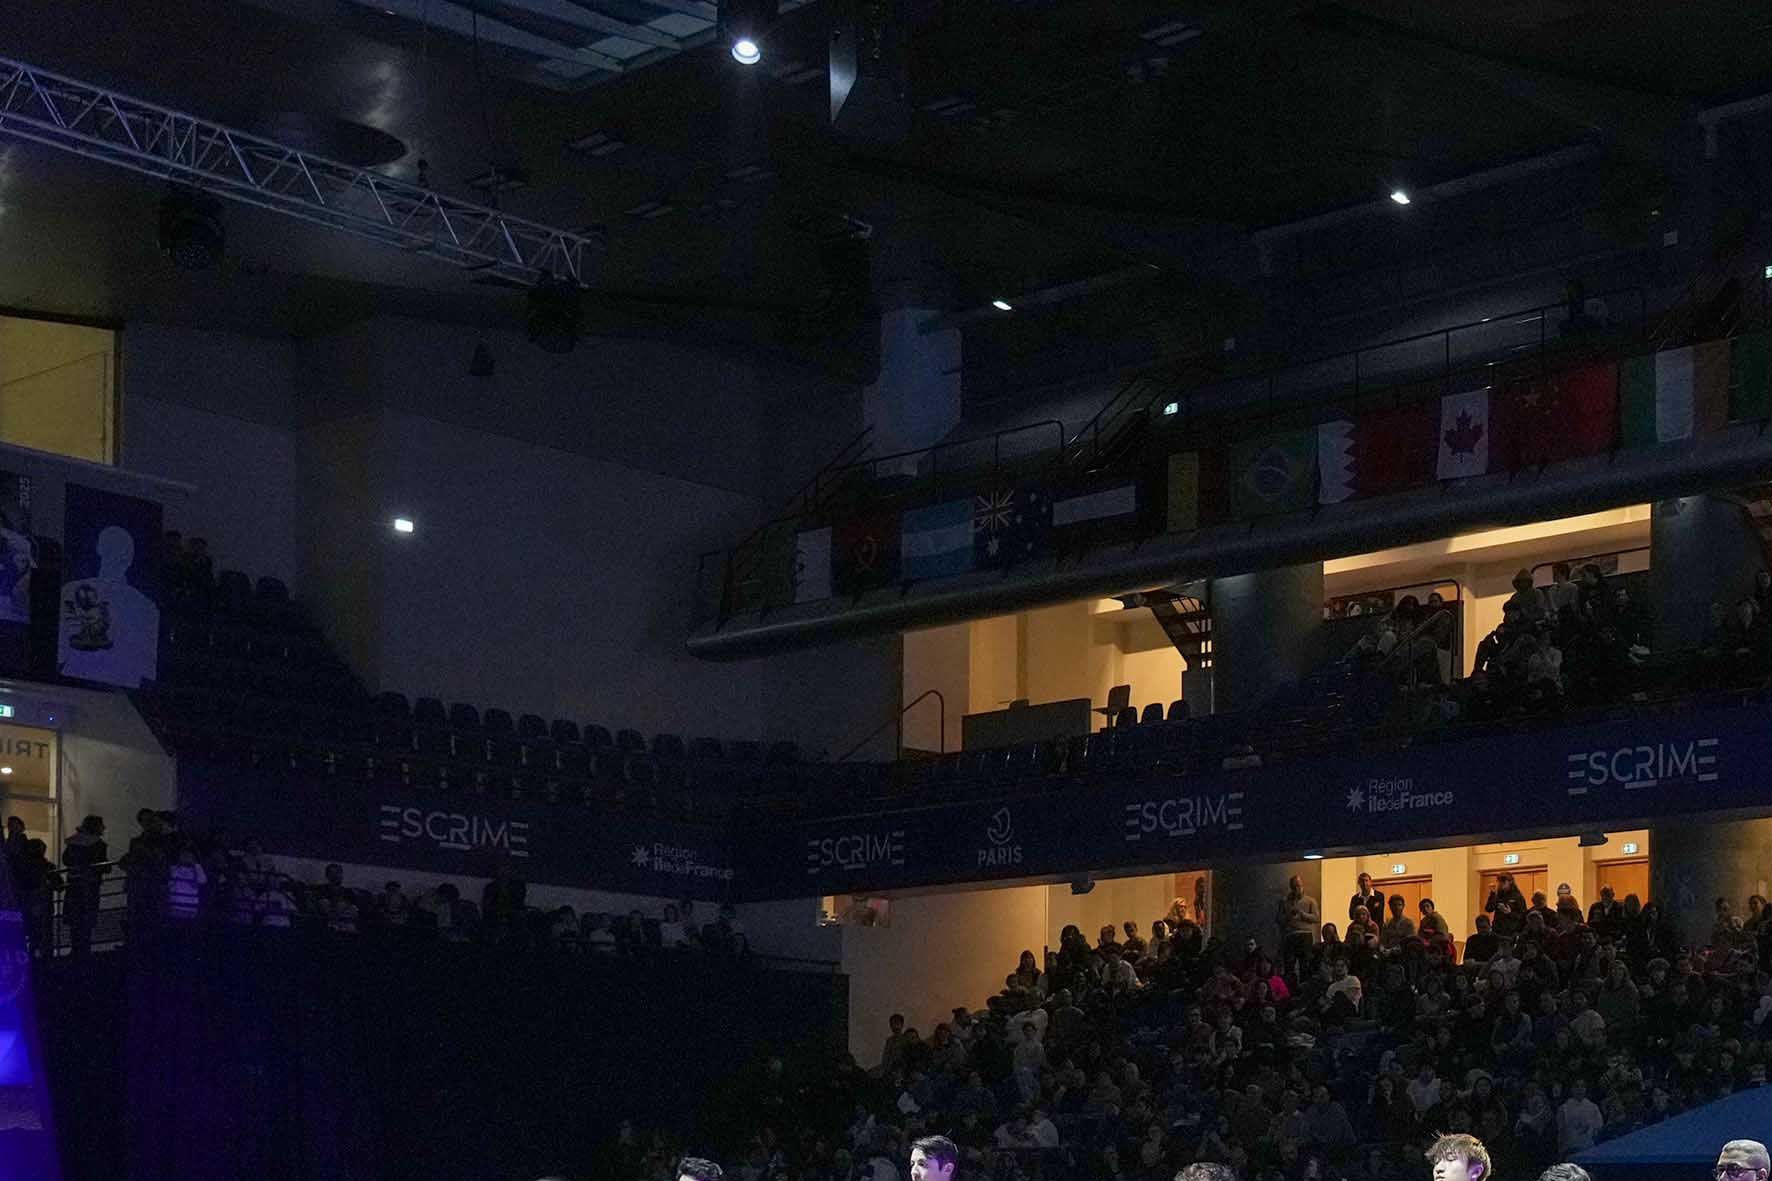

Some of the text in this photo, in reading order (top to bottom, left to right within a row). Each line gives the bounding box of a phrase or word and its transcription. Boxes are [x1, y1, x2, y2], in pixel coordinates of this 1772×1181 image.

[1567, 737, 1719, 796] ESCRIME
[379, 804, 529, 857] ESCRIME
[1125, 791, 1245, 841] ESCRIME
[807, 830, 904, 874] ESCRIME
[976, 845, 1024, 866] PARIS
